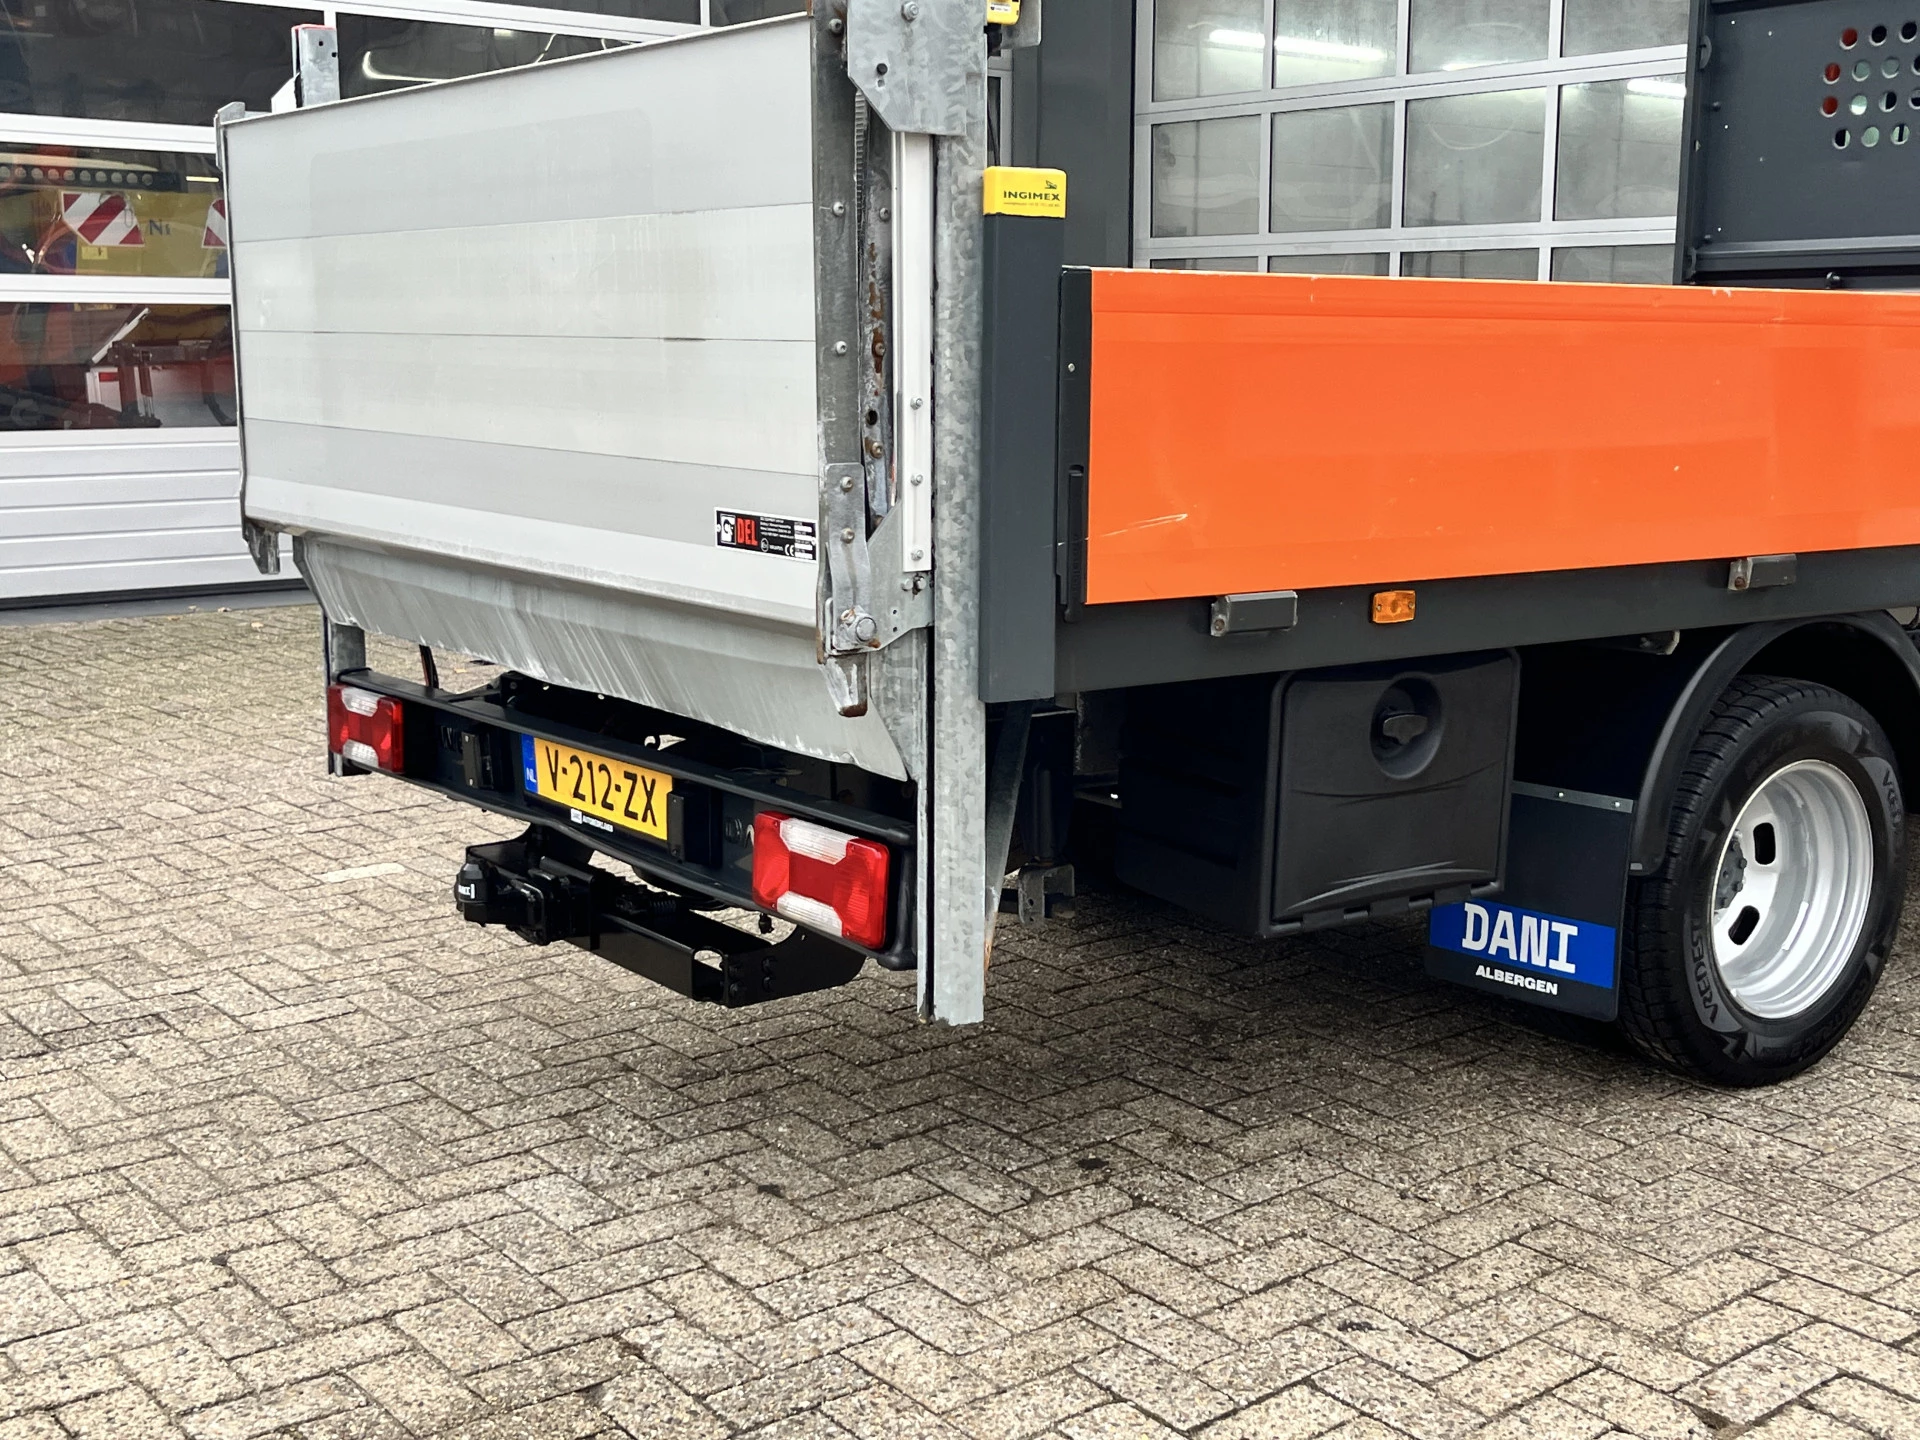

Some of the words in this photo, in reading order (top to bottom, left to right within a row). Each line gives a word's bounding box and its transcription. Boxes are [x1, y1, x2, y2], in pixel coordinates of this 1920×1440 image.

[1003, 190, 1061, 201] INGIMEX
[736, 517, 758, 547] DEL
[526, 767, 537, 783] NL
[545, 746, 657, 827] V-212-ZX
[1461, 902, 1579, 975] DANI
[1475, 964, 1559, 996] ALBERGEN
